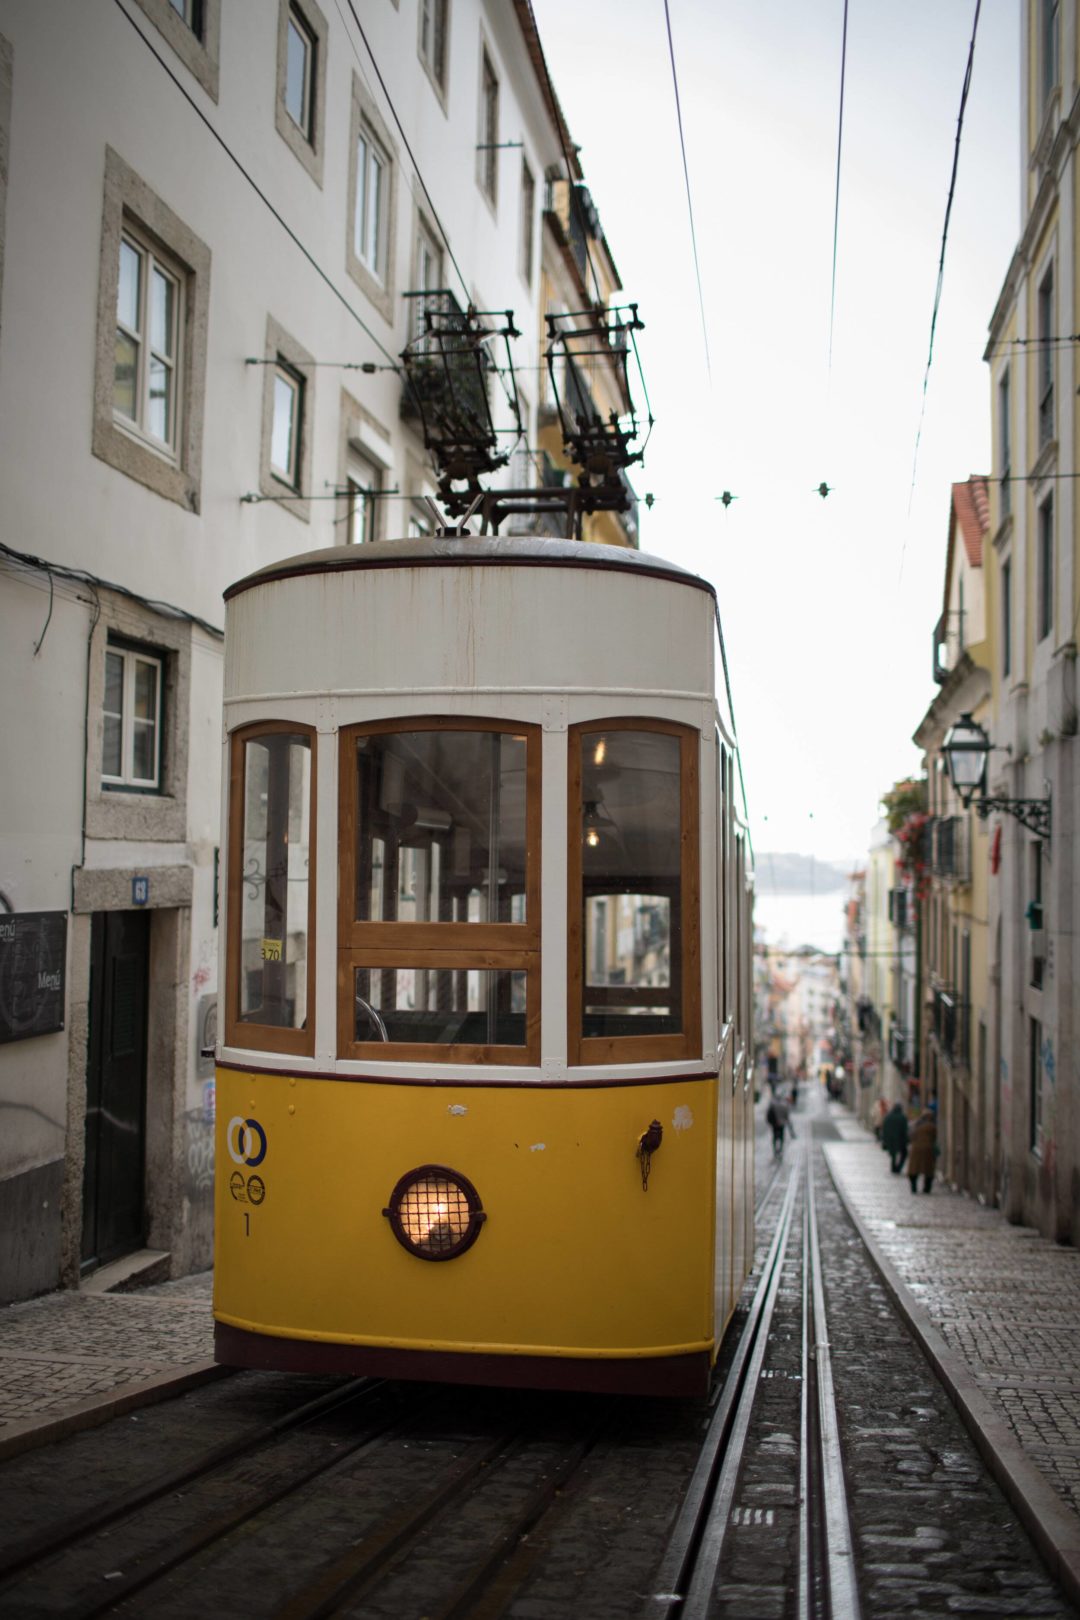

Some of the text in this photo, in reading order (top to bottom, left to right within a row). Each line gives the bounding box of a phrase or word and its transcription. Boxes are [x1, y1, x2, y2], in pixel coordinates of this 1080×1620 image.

[0, 919, 16, 937] enú
[38, 969, 60, 989] Menú
[244, 1212, 250, 1237] 1
